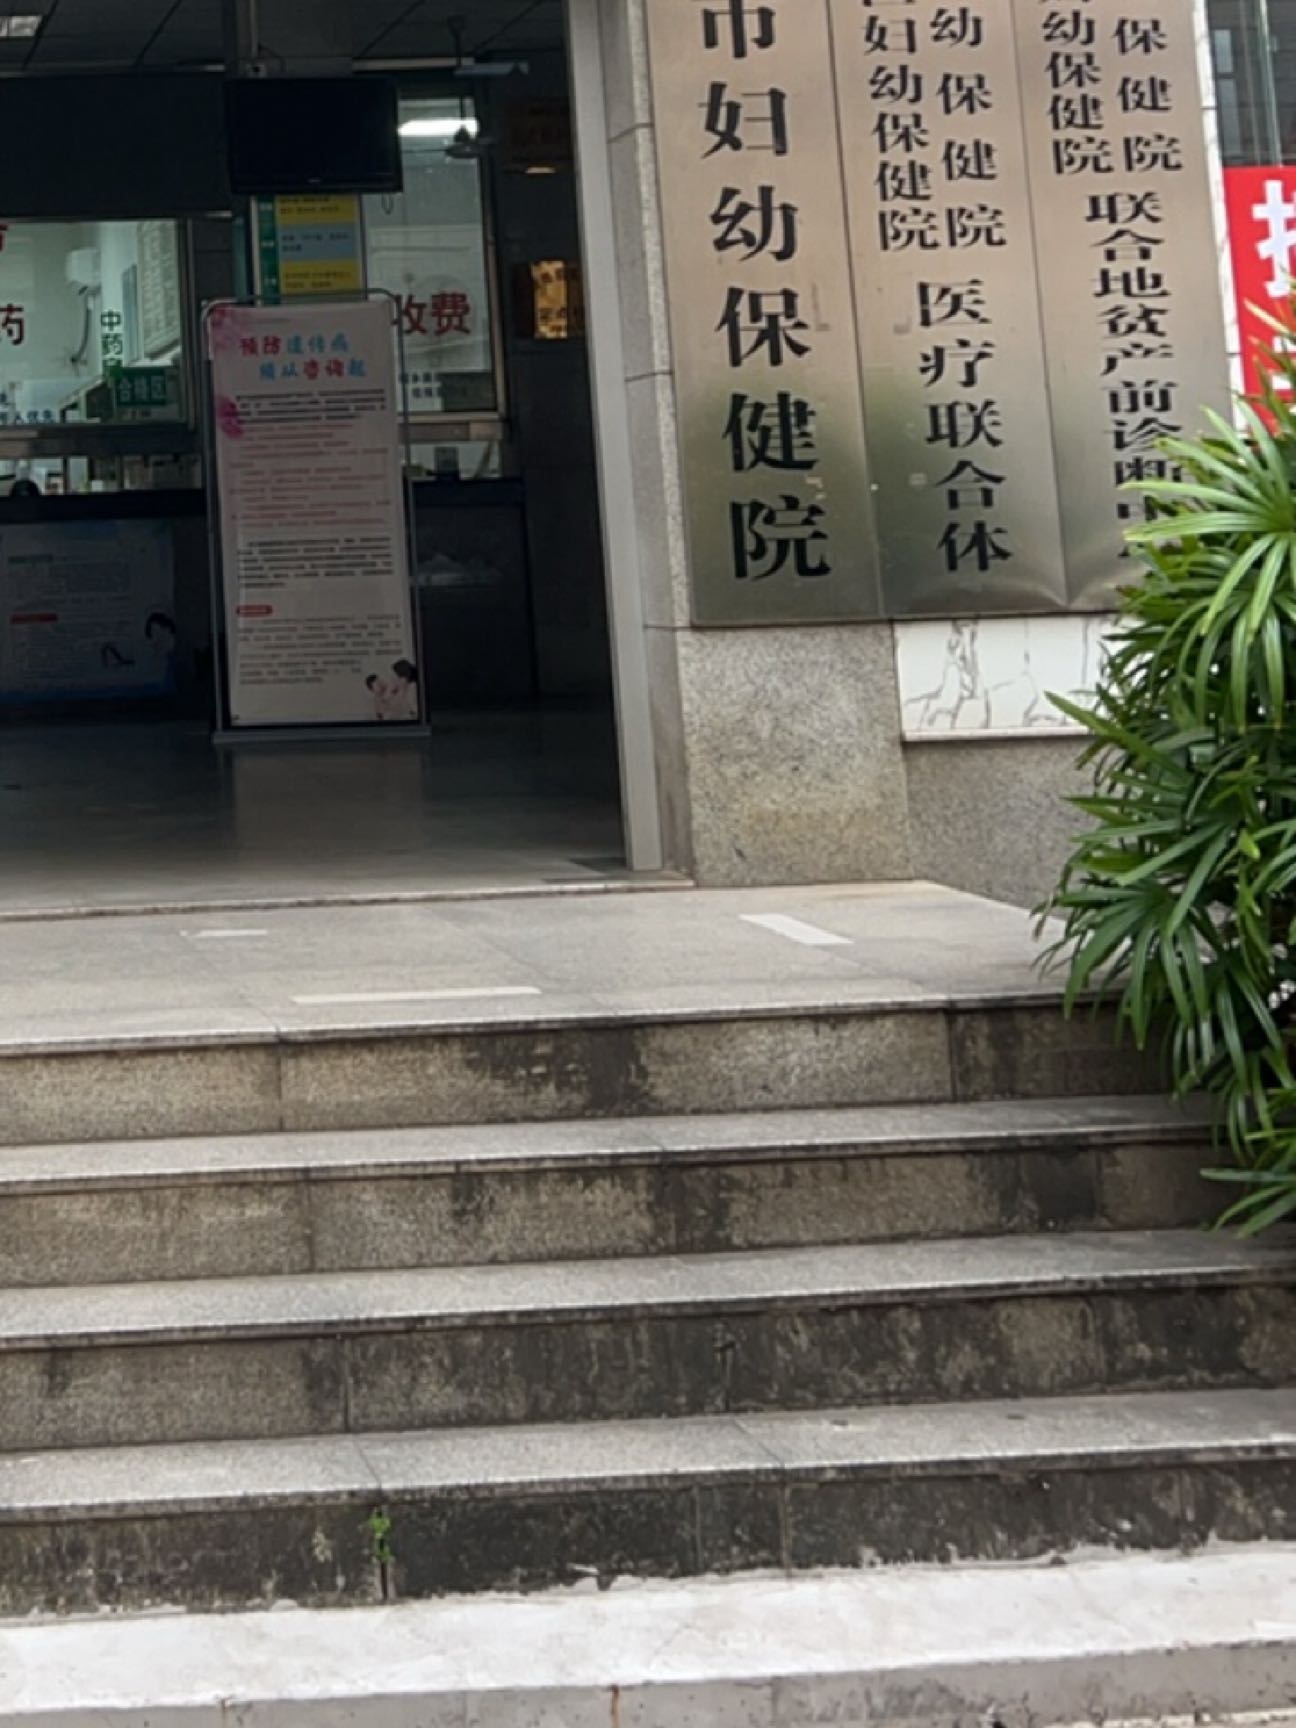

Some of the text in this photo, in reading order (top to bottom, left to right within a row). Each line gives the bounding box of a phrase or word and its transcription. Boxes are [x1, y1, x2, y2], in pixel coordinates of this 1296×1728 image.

[916, 278, 1015, 572] 医疗联合体
